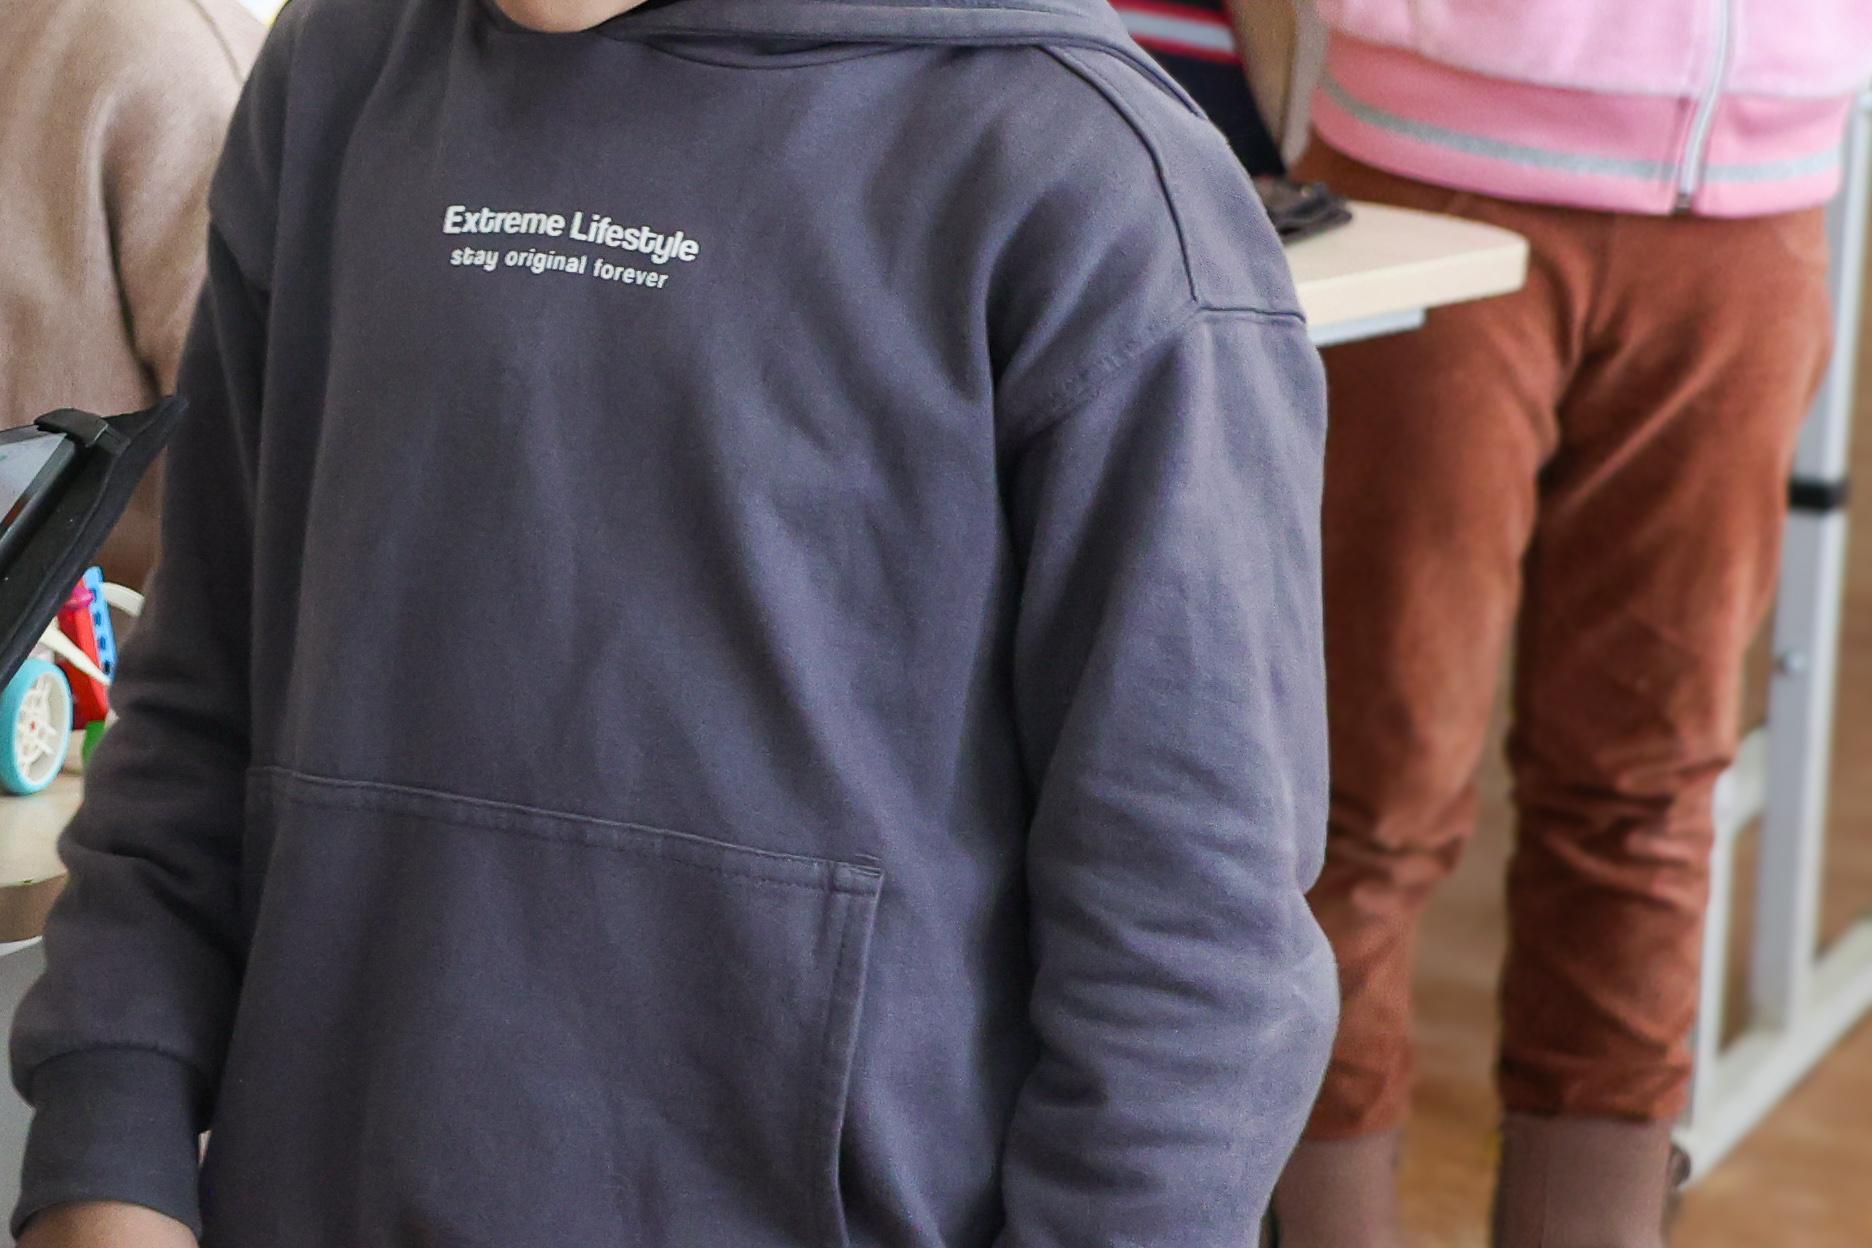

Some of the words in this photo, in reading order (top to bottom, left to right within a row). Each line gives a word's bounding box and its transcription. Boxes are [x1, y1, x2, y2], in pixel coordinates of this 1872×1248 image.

[442, 205, 566, 237] Extreme
[569, 211, 700, 265] Lifestyle
[450, 246, 499, 272] stay
[504, 248, 588, 274] original
[592, 258, 669, 289] forever
